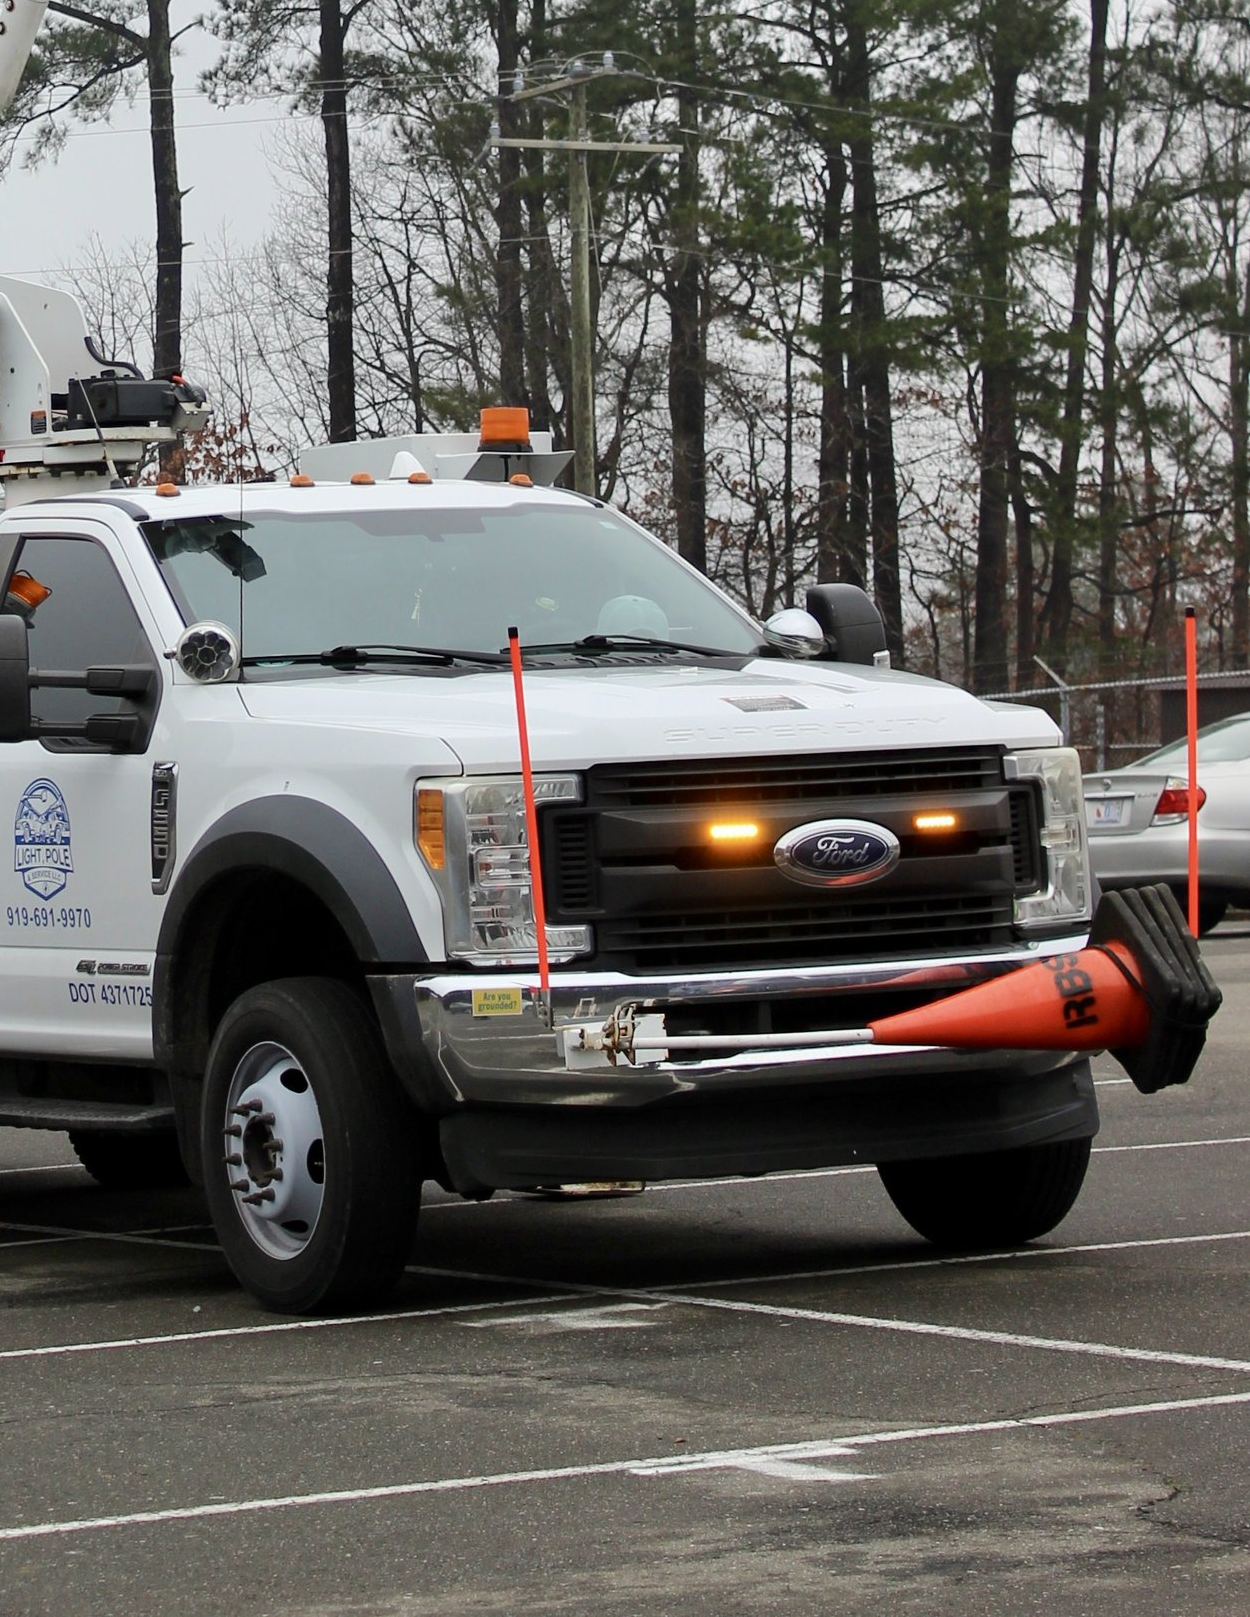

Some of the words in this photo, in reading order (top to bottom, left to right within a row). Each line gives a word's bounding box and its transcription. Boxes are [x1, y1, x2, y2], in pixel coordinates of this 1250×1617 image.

[46, 848, 71, 868] POLE
[813, 837, 869, 866] Ford
[31, 870, 51, 880] SERVICE
[52, 872, 62, 881] LLC
[7, 906, 91, 928] 919-691-9970
[68, 983, 96, 1003] DOT
[101, 984, 153, 1006] 4371725
[483, 992, 496, 1001] Are
[497, 993, 511, 1002] you
[477, 1000, 517, 1013] grounded?
